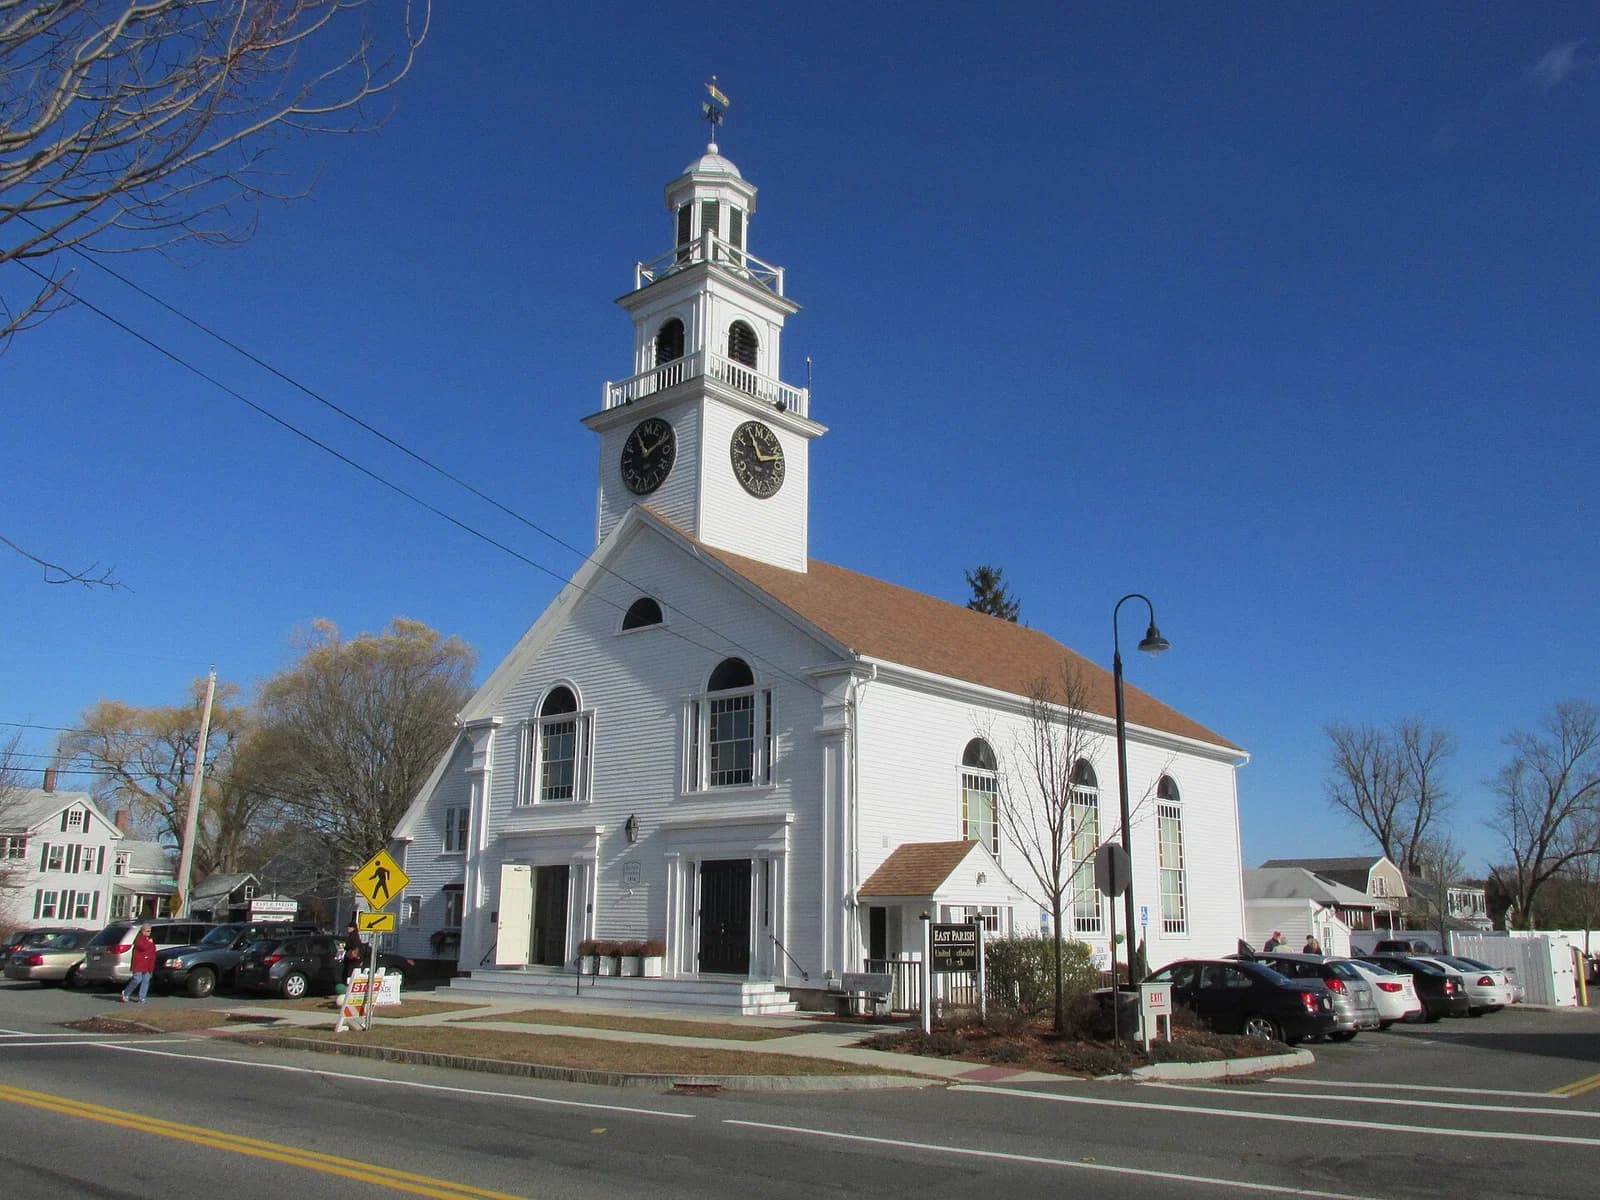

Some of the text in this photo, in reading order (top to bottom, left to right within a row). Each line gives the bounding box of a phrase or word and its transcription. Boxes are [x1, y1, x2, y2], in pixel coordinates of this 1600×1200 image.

[934, 930, 975, 942] EAST PARISH
[1150, 992, 1163, 1003] EXIT
